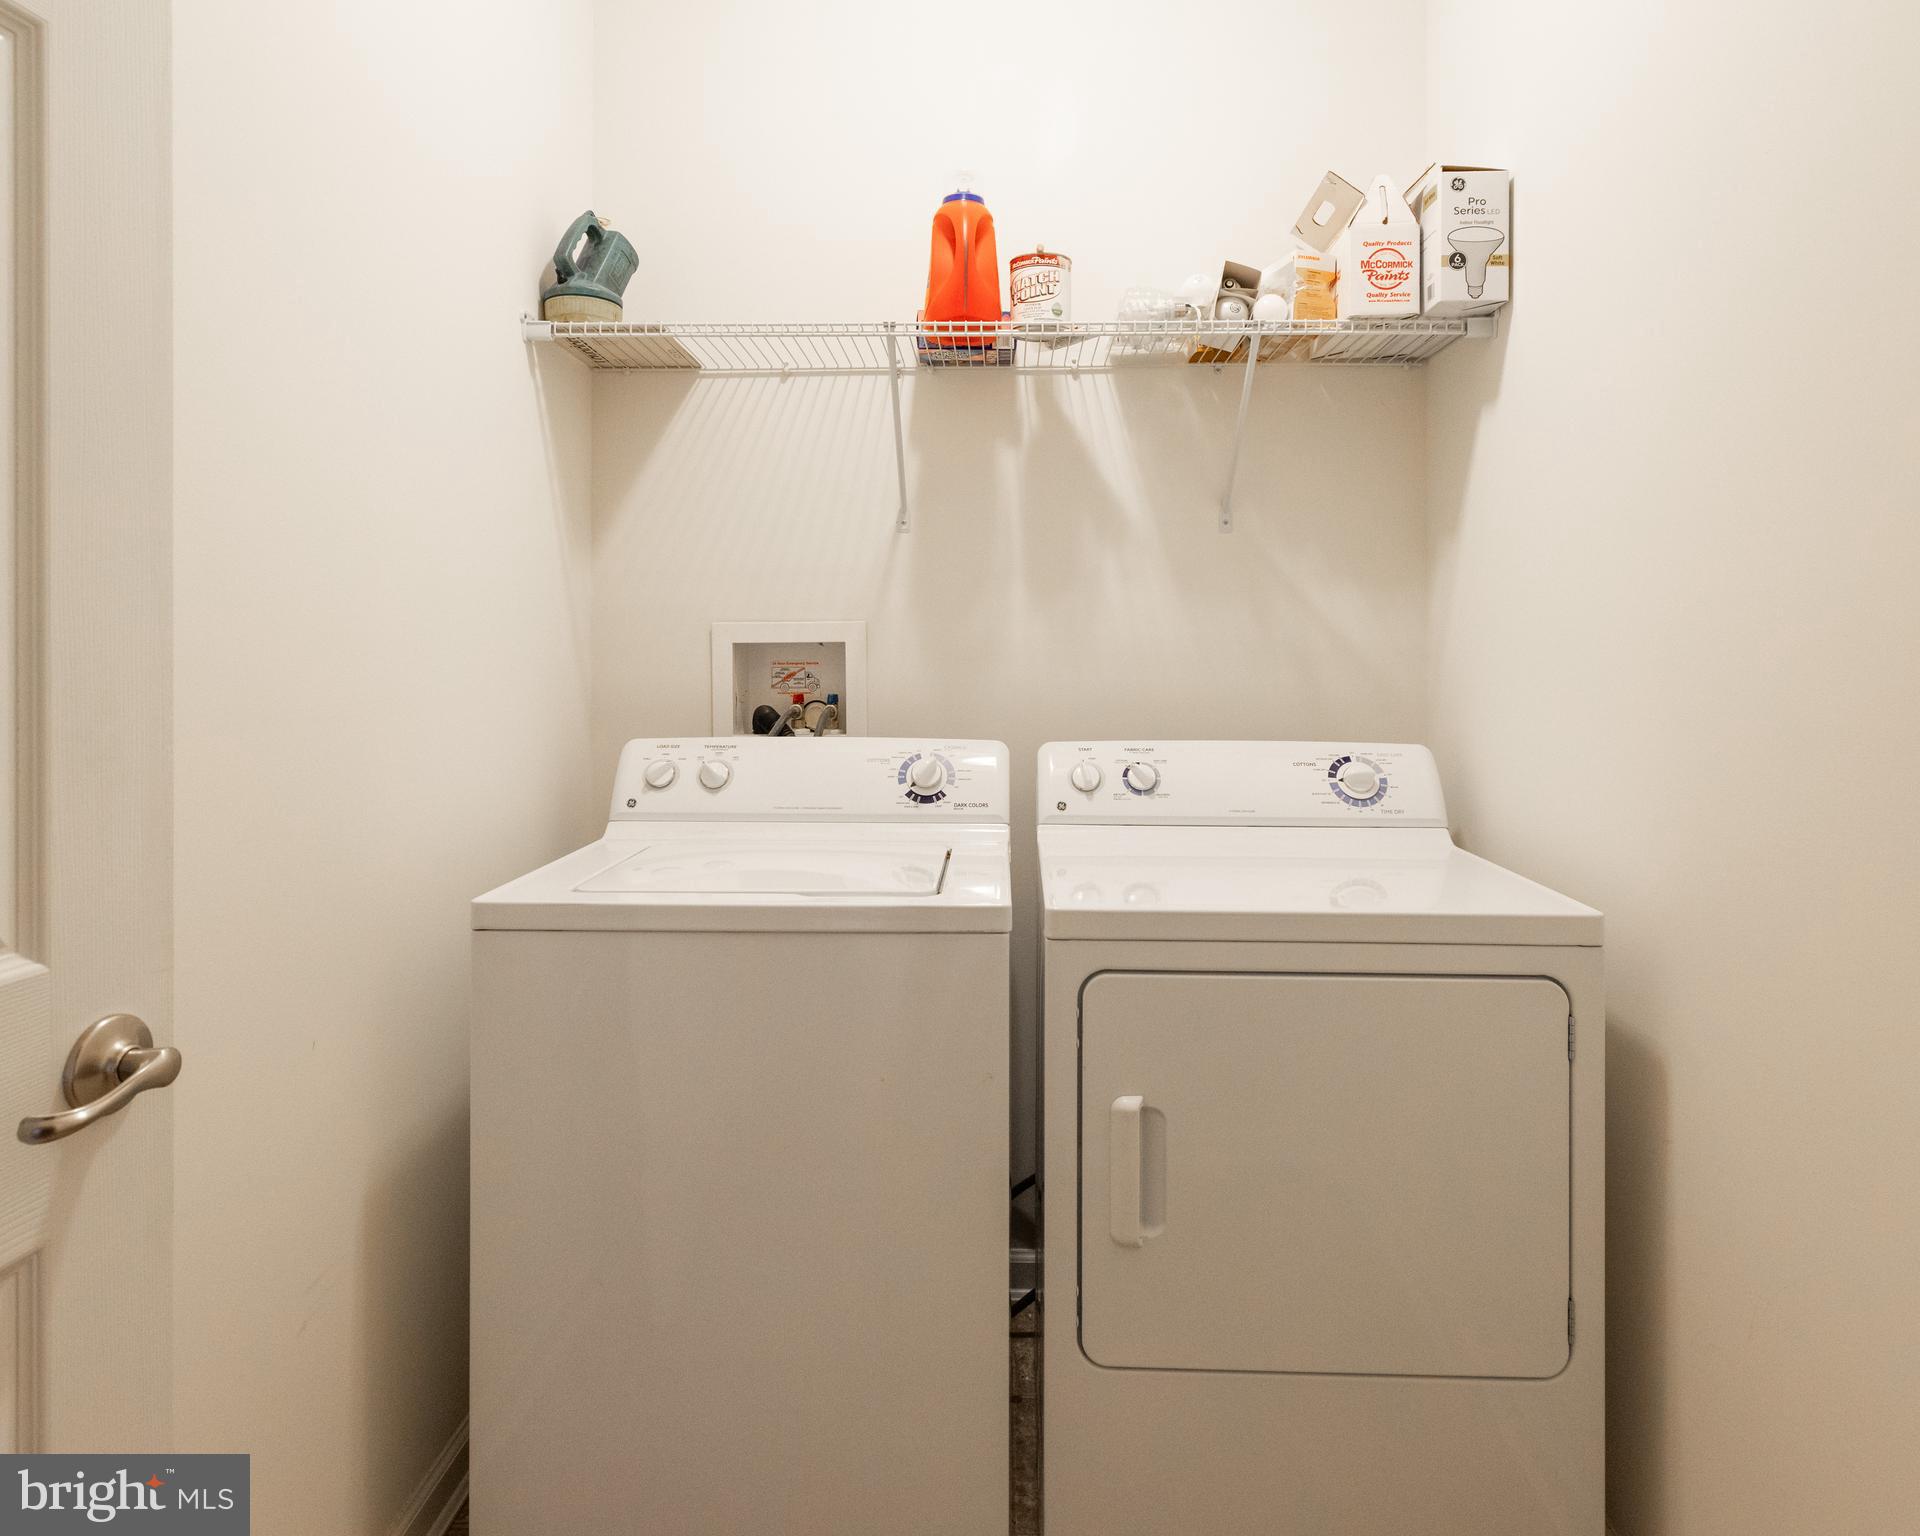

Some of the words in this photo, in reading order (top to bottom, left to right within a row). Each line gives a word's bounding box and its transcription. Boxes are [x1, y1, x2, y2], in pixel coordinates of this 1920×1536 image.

[1468, 197, 1487, 206] Pro
[1453, 206, 1486, 215] Series
[1031, 256, 1058, 265] Paints
[1454, 253, 1462, 263] 6
[1361, 269, 1410, 281] Paints
[1012, 283, 1057, 307] POINT
